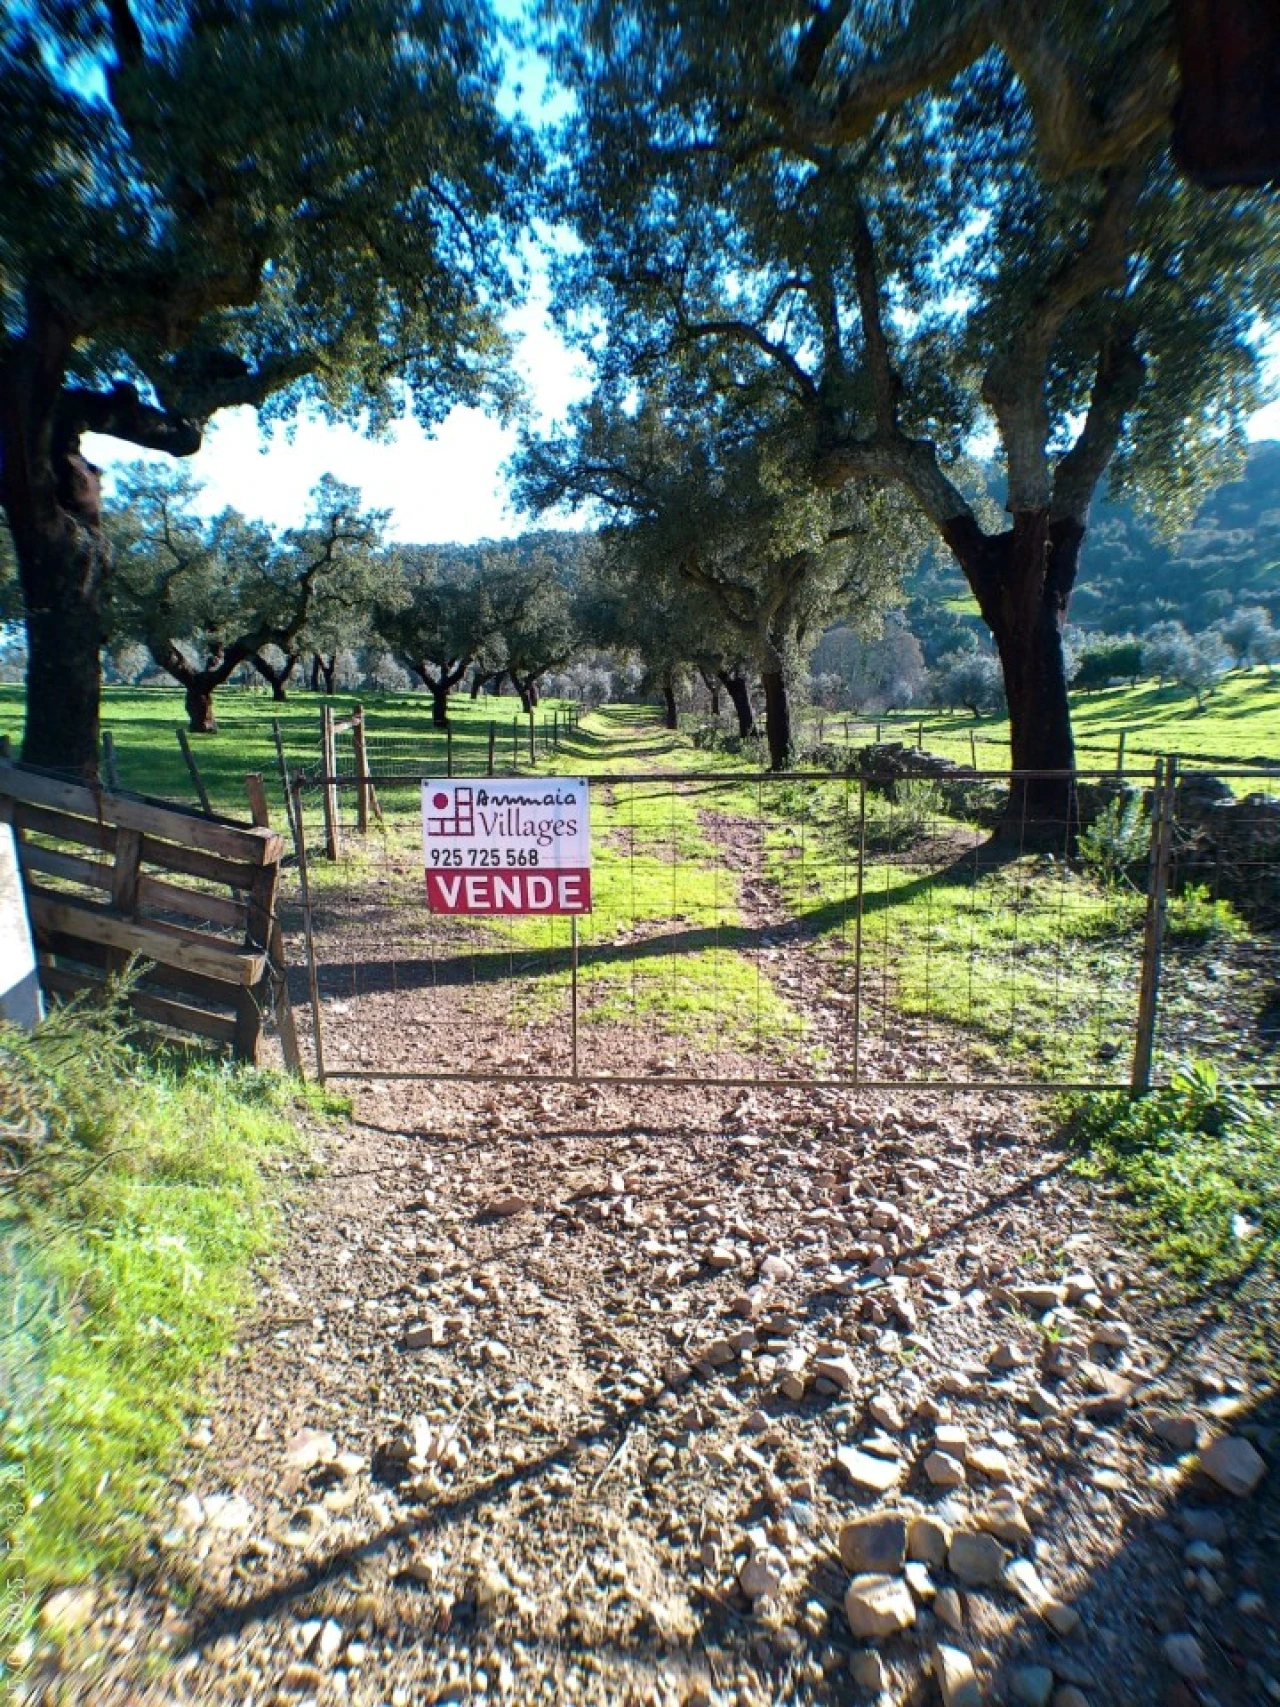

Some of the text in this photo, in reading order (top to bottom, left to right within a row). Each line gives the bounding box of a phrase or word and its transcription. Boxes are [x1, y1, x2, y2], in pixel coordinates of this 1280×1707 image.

[478, 807, 578, 847] Villages
[431, 849, 539, 867] 925 725 568
[435, 875, 584, 909] VENDE
